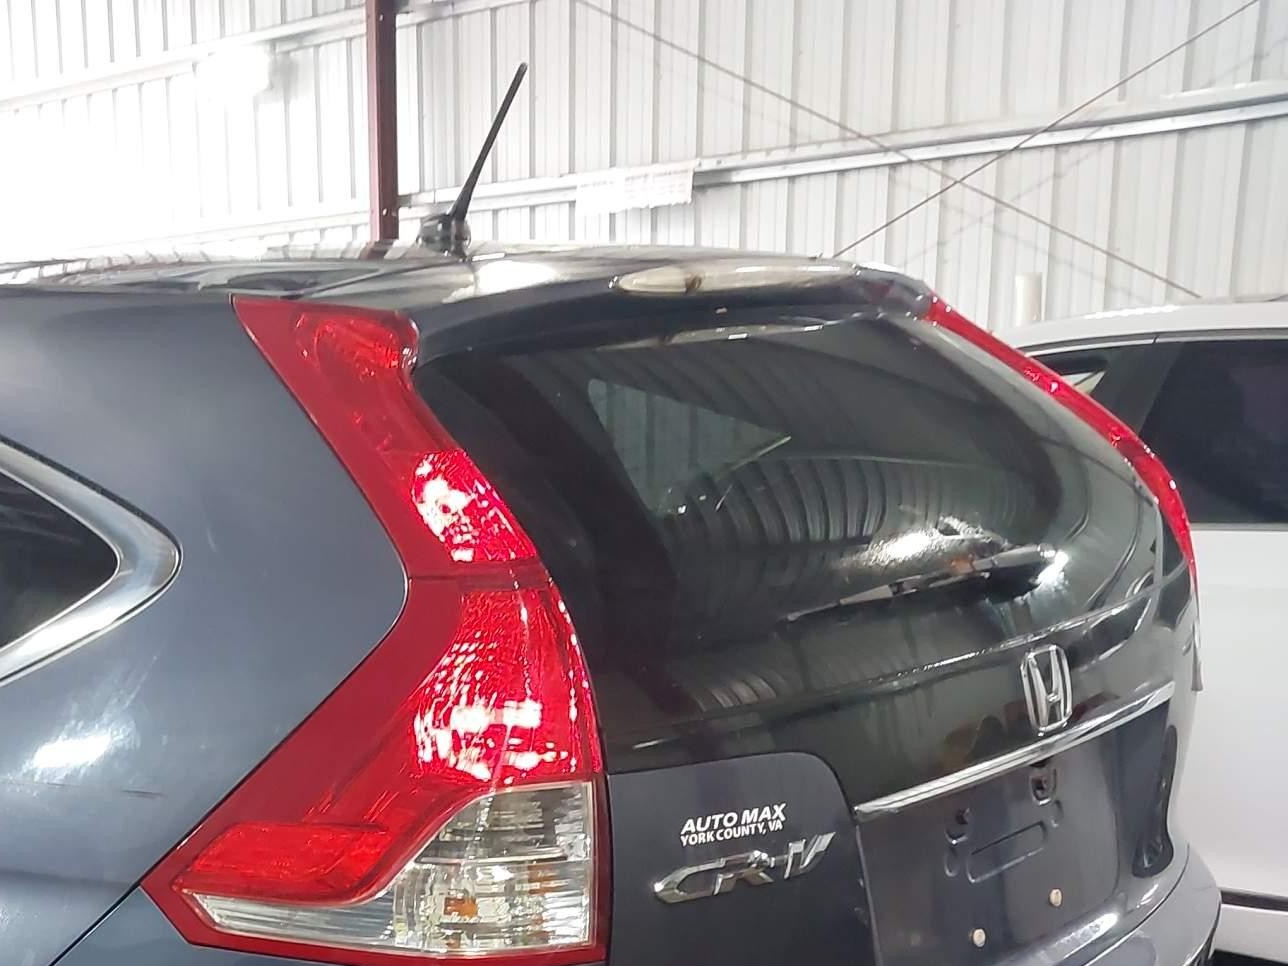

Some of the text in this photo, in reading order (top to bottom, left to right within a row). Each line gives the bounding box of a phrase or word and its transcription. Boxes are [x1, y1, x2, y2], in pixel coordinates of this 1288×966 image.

[680, 802, 787, 836] AUTO MAX
[680, 830, 715, 847] YORK
[768, 819, 783, 833] VA
[654, 832, 836, 903] CR-V
